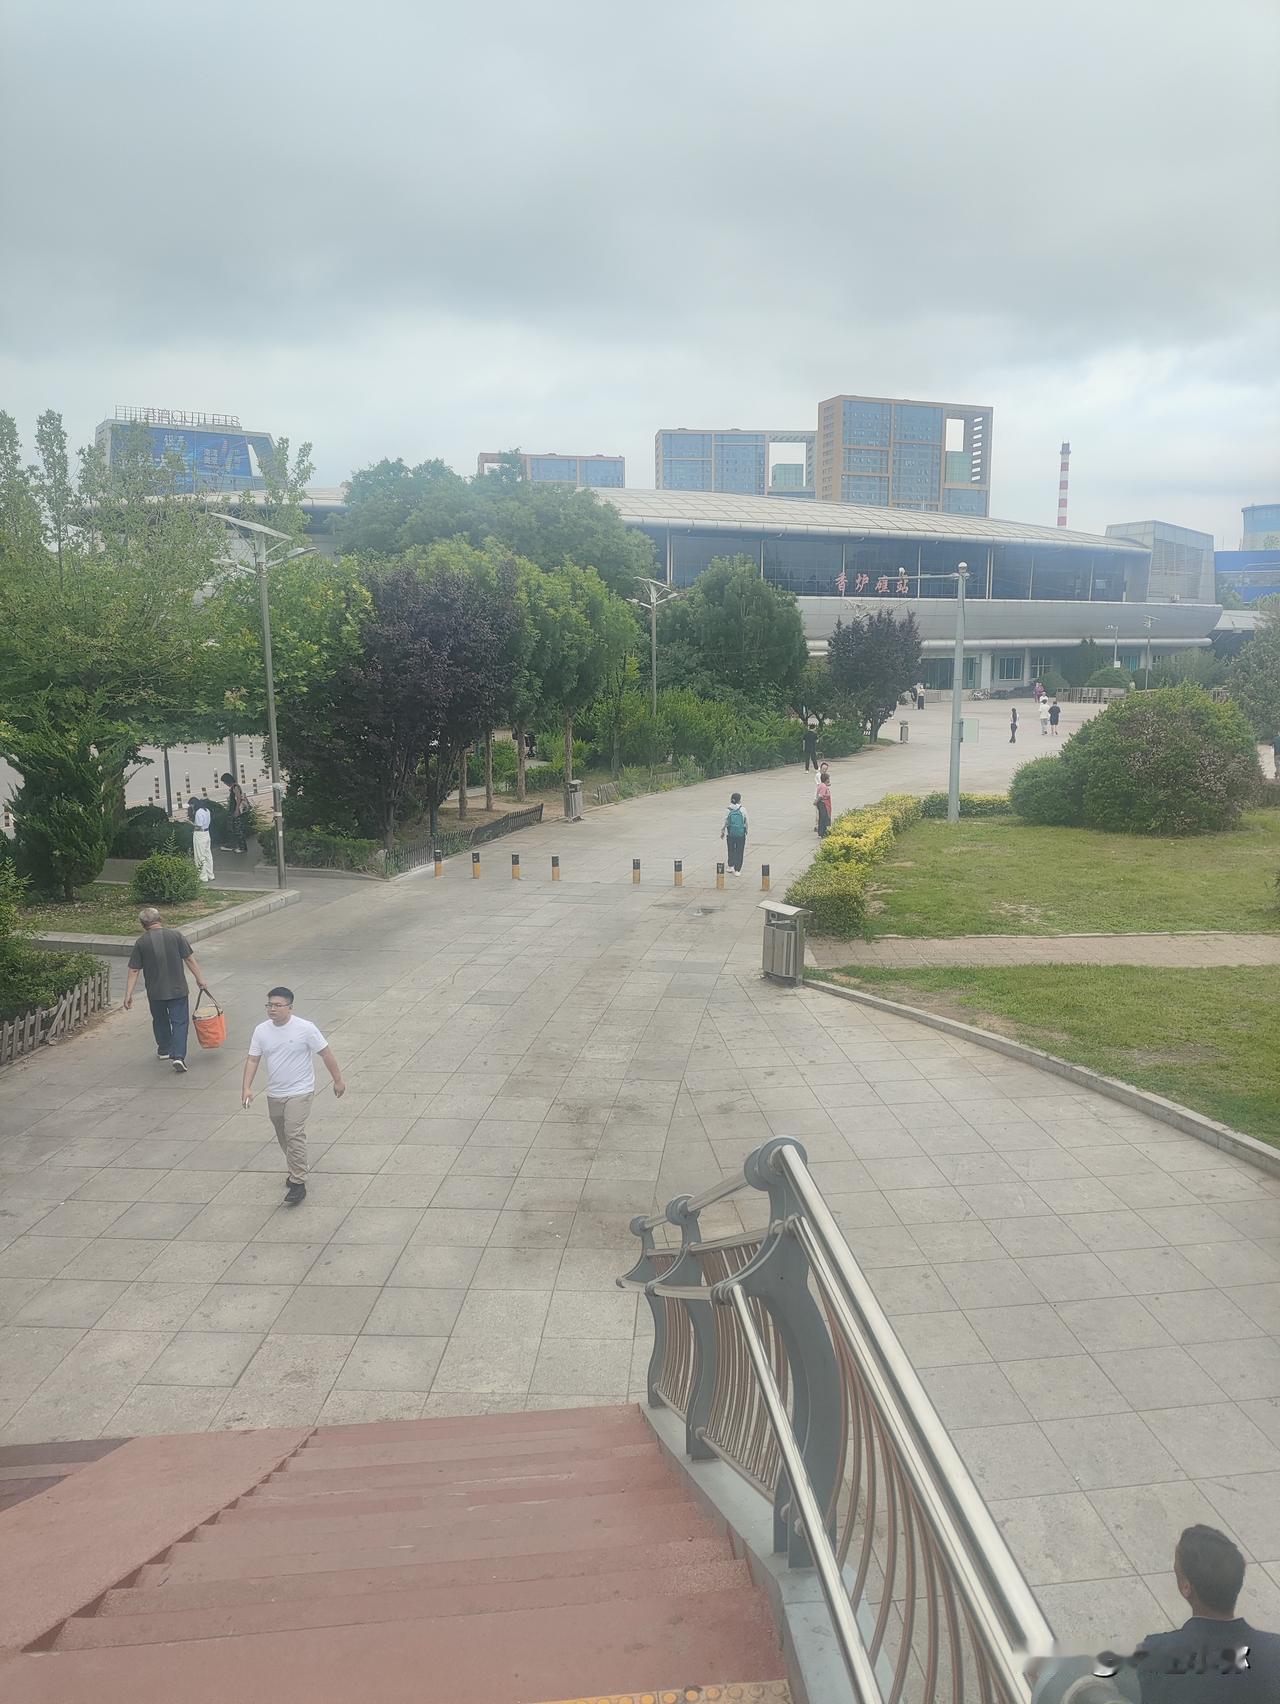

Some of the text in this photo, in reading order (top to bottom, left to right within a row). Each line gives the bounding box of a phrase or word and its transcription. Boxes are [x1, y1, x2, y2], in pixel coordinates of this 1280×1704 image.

[171, 409, 240, 427] OUTLETS
[835, 571, 909, 594] 香炉礁站
